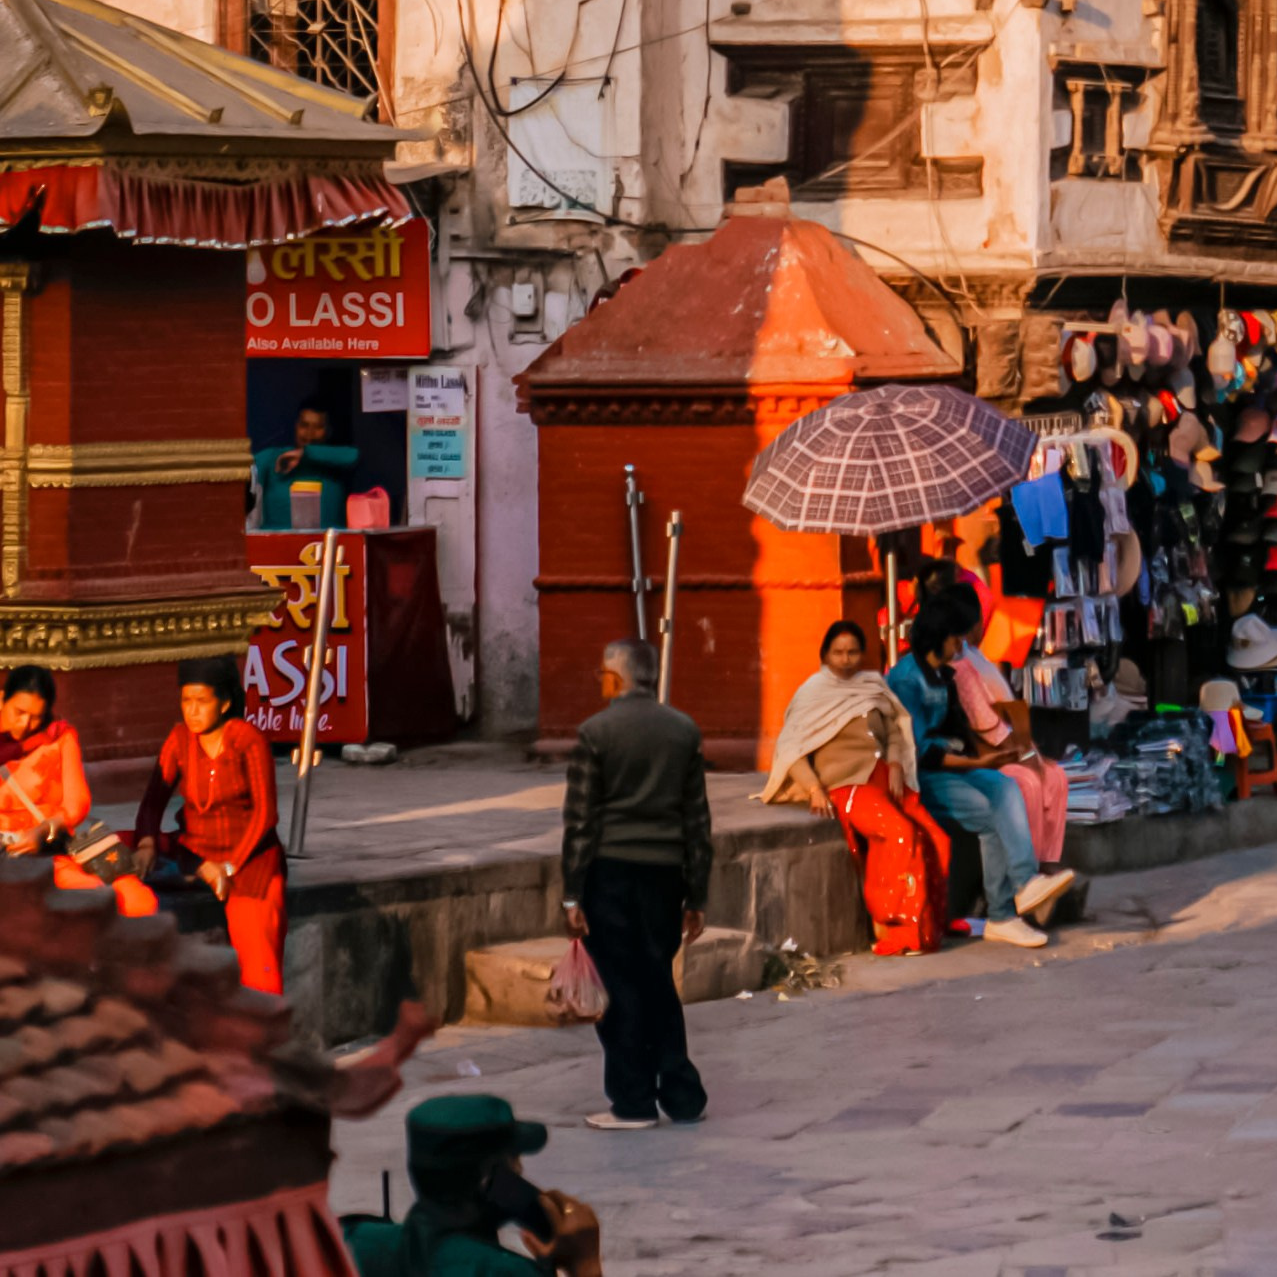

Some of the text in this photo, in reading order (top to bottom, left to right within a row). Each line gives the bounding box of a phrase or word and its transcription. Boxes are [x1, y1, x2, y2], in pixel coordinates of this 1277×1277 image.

[289, 291, 405, 328] LASSI
[281, 336, 344, 351] Available
[347, 337, 380, 351] Here
